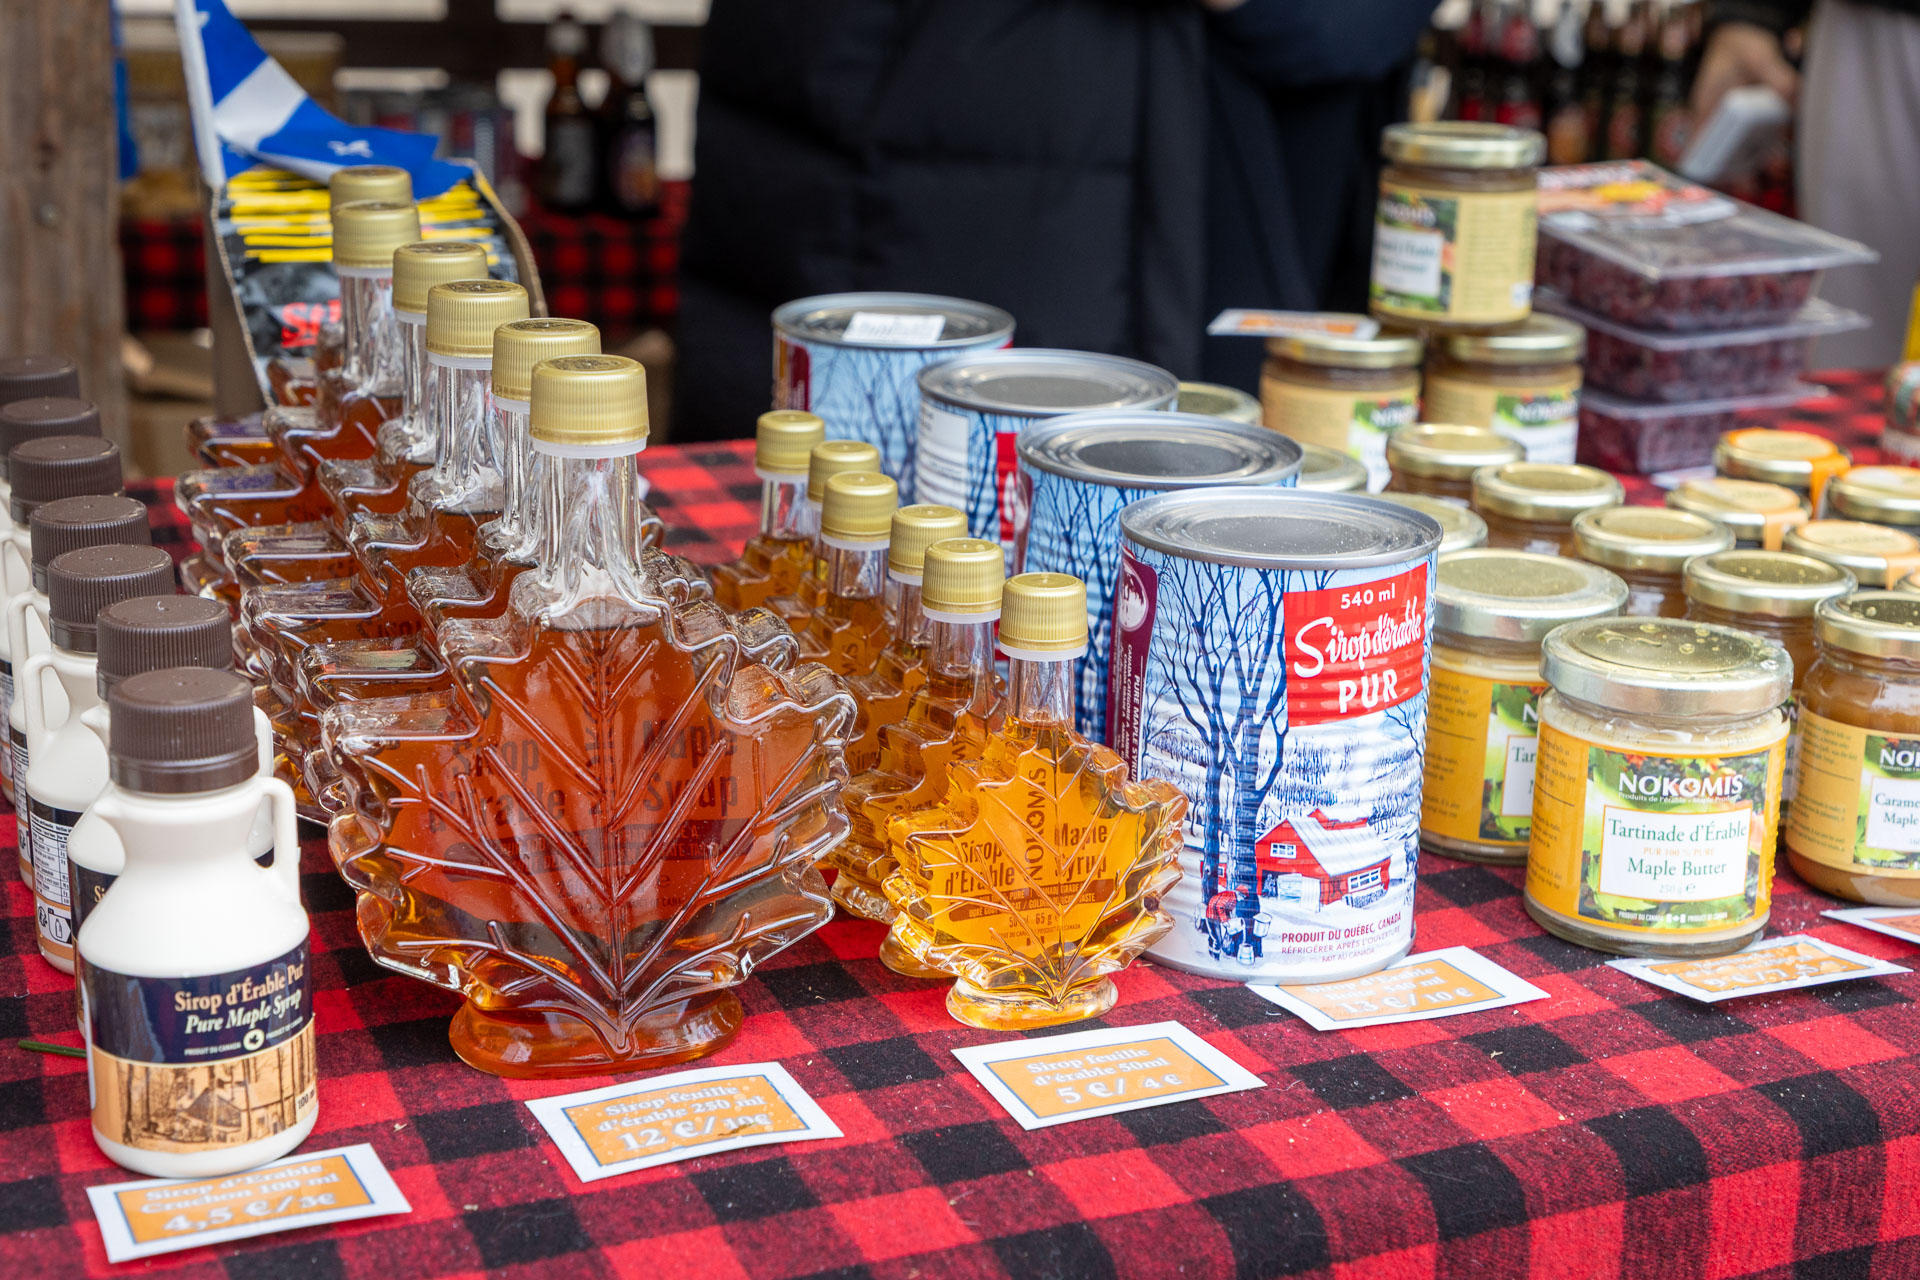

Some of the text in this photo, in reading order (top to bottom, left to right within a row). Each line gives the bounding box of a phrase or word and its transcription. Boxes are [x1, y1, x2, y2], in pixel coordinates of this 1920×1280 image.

[1340, 582, 1396, 609] 540 ml
[1293, 616, 1371, 678] Sirop
[1133, 674, 1141, 704] PURE
[1338, 668, 1398, 714] PUR
[1132, 706, 1140, 744] MAPLE
[1618, 773, 1744, 798] NOKOMIS
[1618, 792, 1648, 802] Produits
[1608, 818, 1747, 843] Tartinade d'Érable
[1883, 811, 1919, 828] Maple
[1627, 857, 1727, 880] Maple Butter
[1035, 913, 1045, 925] 65
[1281, 931, 1325, 943] PRODUIT
[1328, 929, 1341, 941] DU
[1377, 911, 1402, 930] CANADA
[1281, 944, 1333, 954] RÉFRIGÉRER
[1336, 940, 1360, 951] APRÈS
[1348, 947, 1375, 959] CANADA
[175, 963, 304, 1015] Sirop d'Érable Pur
[185, 989, 302, 1034] Pure Maple Syrup
[1026, 1048, 1151, 1074] Sirop feuille
[1033, 1066, 1117, 1087] d'érable
[297, 1094, 309, 1110] 100
[605, 1084, 740, 1117] Sirop feuille
[1056, 1086, 1081, 1104] 5
[597, 1094, 768, 1132] d'érable 250 ml
[617, 1128, 667, 1151] 12
[145, 1183, 213, 1200] Sirop
[258, 1179, 300, 1194] 100
[304, 1172, 340, 1186] ml
[162, 1206, 234, 1232] 4,5
